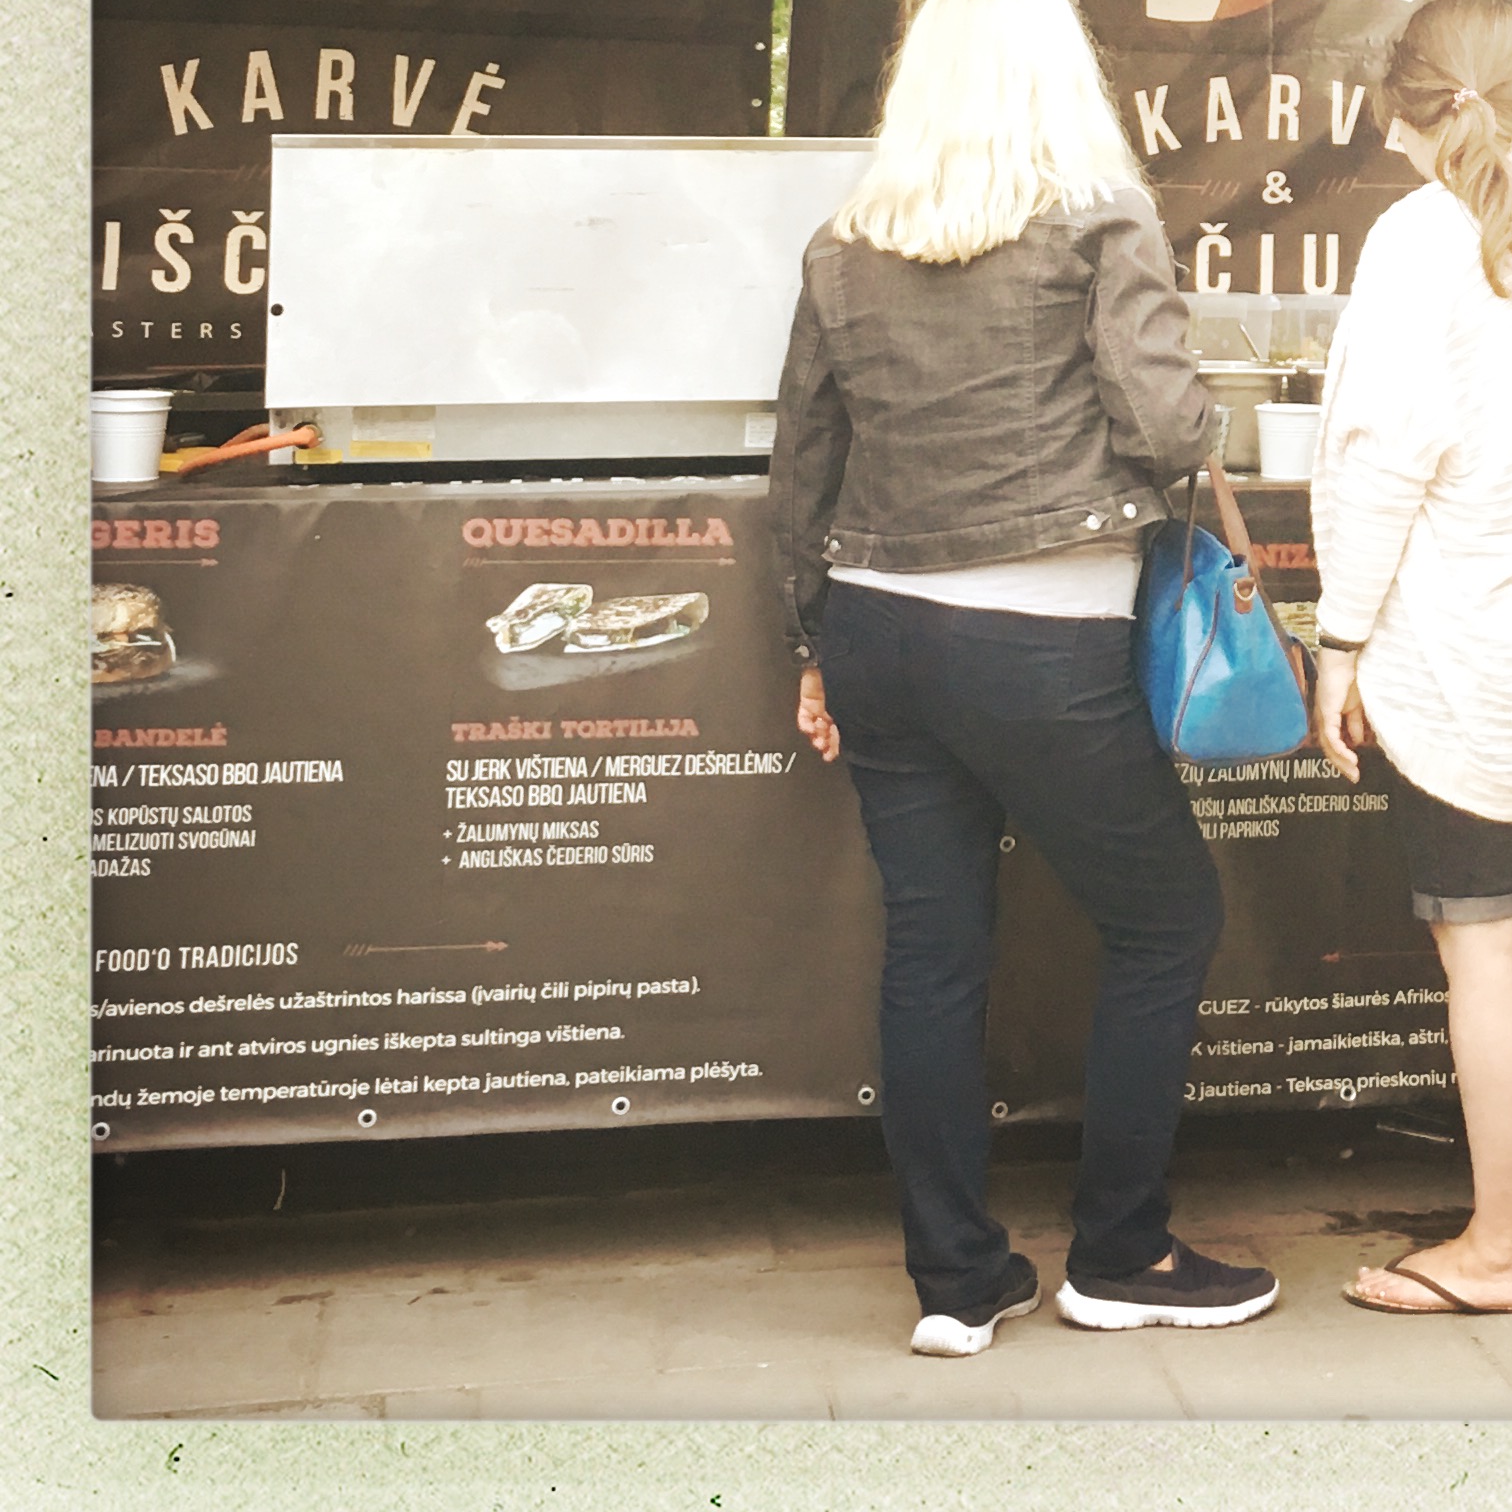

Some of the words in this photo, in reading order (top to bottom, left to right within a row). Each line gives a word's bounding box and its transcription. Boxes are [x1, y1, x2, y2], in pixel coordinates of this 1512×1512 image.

[160, 47, 506, 135] KARVĖ
[1261, 170, 1294, 205] &
[462, 517, 734, 548] QUESADILLA
[94, 722, 228, 747] BANDELĖ
[451, 717, 552, 742] TRAŠKI
[139, 763, 217, 786] TEKSASO
[222, 761, 258, 785] BBQ
[261, 759, 344, 784] JAUTIENA
[446, 758, 470, 782] SU
[471, 757, 511, 781] JERK
[515, 752, 588, 779] VIŠTIENA
[605, 754, 681, 777] MERGUEZ
[684, 750, 782, 775] DEŠRELĖMIS
[446, 785, 524, 809] TEKSASO
[528, 783, 562, 807] BBQ
[567, 781, 647, 805] JAUTIENA
[1227, 794, 1296, 816] ANGLIŠKAS
[1298, 792, 1350, 813] ČEDERIO
[108, 804, 178, 828] KOPŪSTŲ
[182, 804, 252, 824] SALOTOS
[1220, 819, 1280, 840] PAPRIKOS
[91, 832, 174, 852] MELIZUOTI
[178, 828, 256, 850] SVOGŪNAI
[456, 821, 539, 844] ŽALUMYNŲ
[543, 820, 599, 840] MIKSAS
[458, 845, 543, 869] ANGLIŠKAS
[546, 844, 608, 866] ČEDERIO
[611, 842, 654, 863] SŪRIS
[178, 943, 299, 970] TRADICIJOS
[189, 993, 275, 1013] dešrelės
[279, 988, 392, 1010] užaštrintos
[396, 986, 466, 1005] harissa
[541, 982, 569, 999] čili
[574, 981, 632, 1002] pipirų
[1265, 996, 1328, 1014] rūkytos
[1332, 991, 1390, 1009] šiaurės
[179, 1042, 194, 1059] ir
[198, 1041, 233, 1058] ant
[238, 1037, 306, 1057] atviros
[311, 1034, 379, 1057] ugnies
[384, 1032, 456, 1053] iškepta
[461, 1028, 541, 1048] sultinga
[1207, 1037, 1274, 1056] vištiena
[136, 1086, 215, 1108] žemoje
[220, 1078, 370, 1102] temperatūroje
[375, 1076, 419, 1094] lėtai
[423, 1073, 480, 1095] kepta
[575, 1064, 686, 1088] pateikiama
[1199, 1081, 1272, 1101] jautiena
[1357, 1070, 1446, 1092] prieskonių
